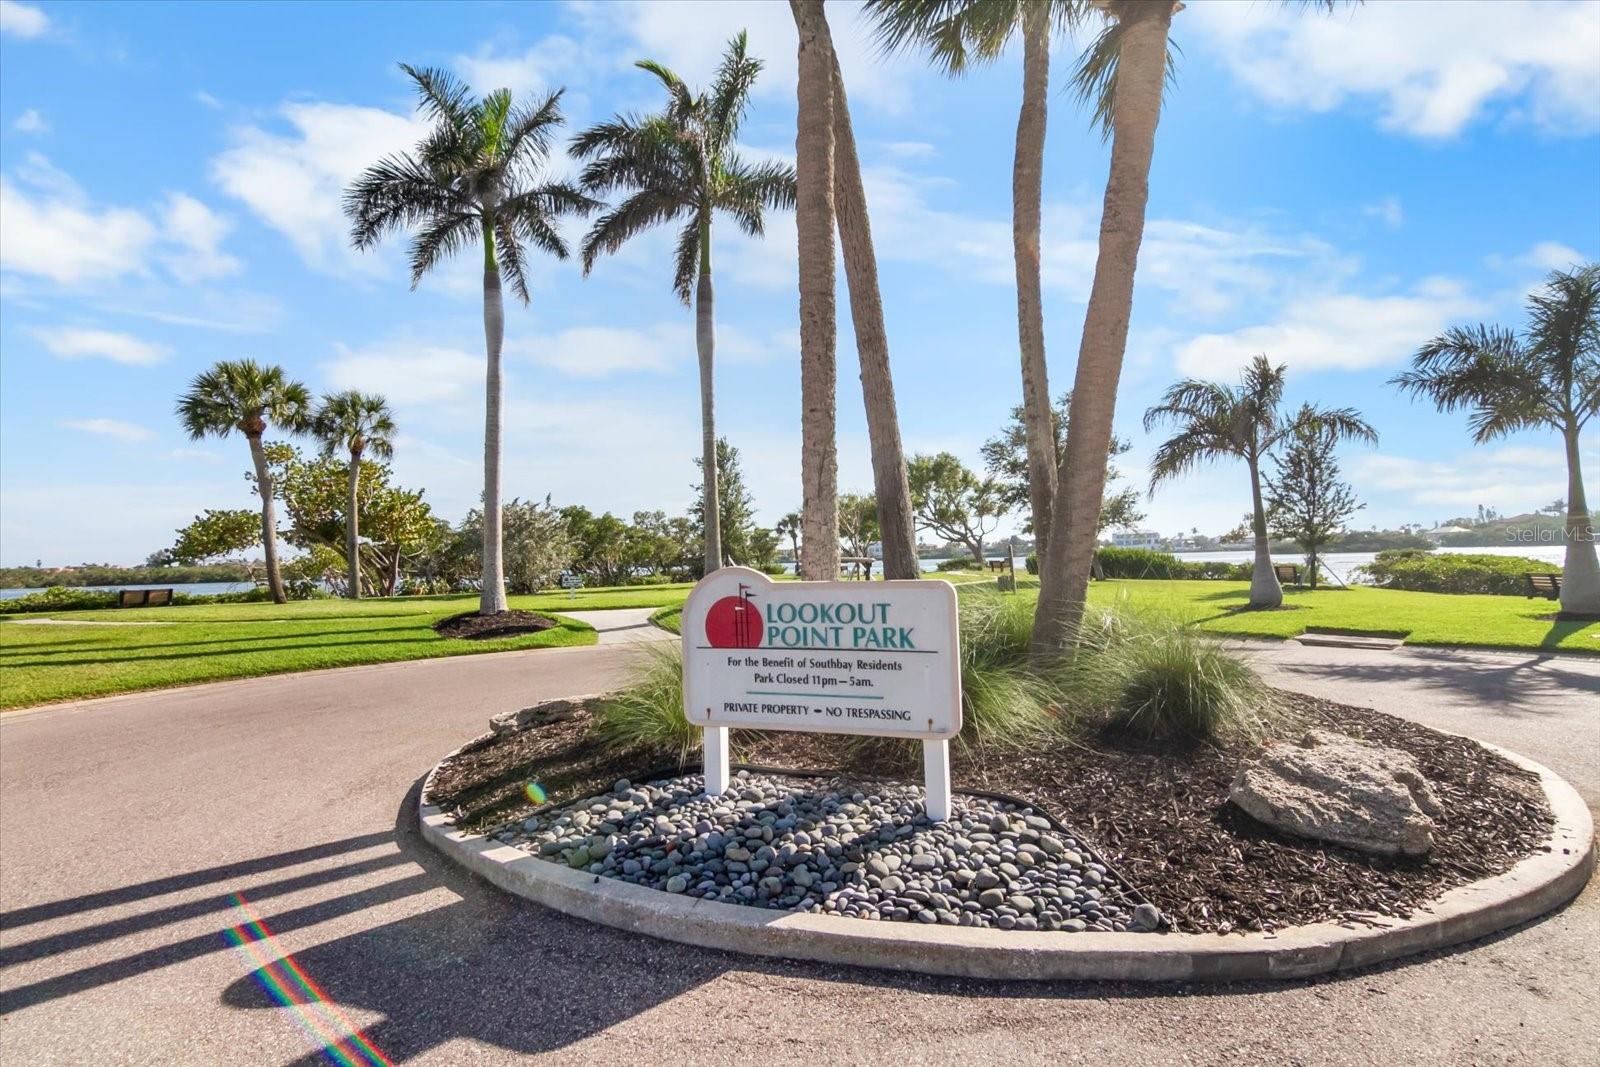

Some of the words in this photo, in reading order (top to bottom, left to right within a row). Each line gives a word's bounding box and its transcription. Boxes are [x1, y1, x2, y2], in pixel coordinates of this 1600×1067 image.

[767, 603, 891, 624] LOOKOUT
[768, 626, 843, 647] POINT
[853, 627, 915, 648] PARK
[728, 657, 741, 666] For
[745, 657, 759, 667] the
[762, 658, 794, 668] Benefit
[797, 658, 806, 668] of
[810, 659, 852, 670] Southbay
[857, 660, 902, 671] Residents
[754, 673, 774, 683] Park
[777, 674, 809, 684] Closed
[724, 703, 758, 713] PRIVATE
[761, 704, 809, 715] PROPERTY
[826, 707, 842, 717] NO
[846, 708, 911, 721] TRESPASSING
